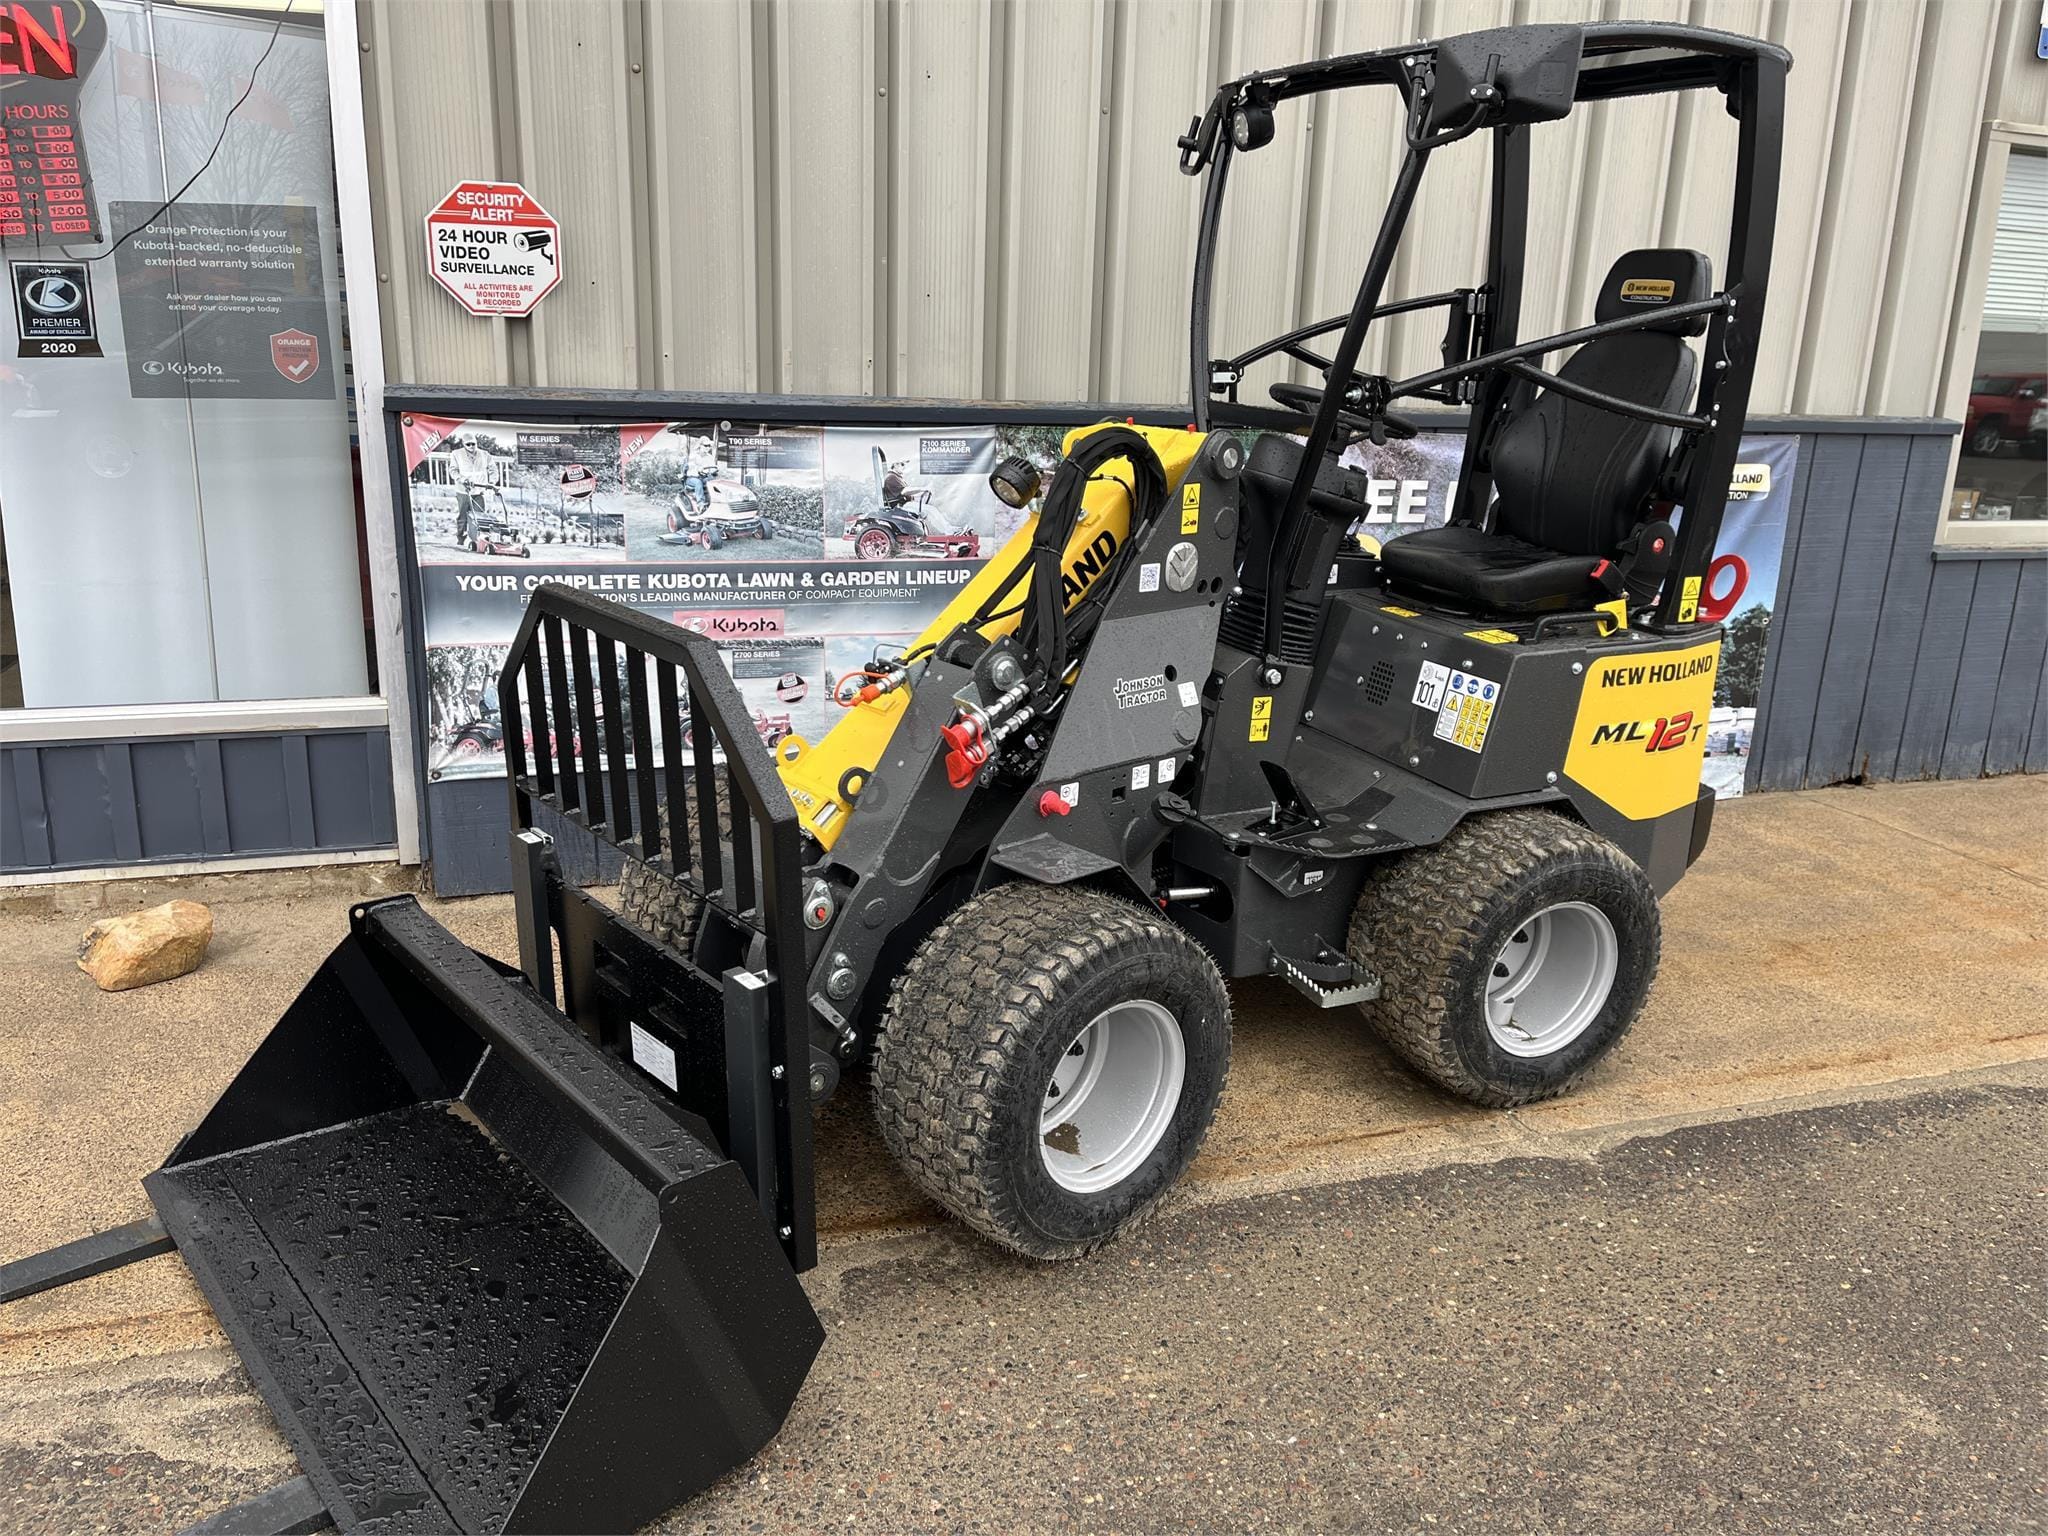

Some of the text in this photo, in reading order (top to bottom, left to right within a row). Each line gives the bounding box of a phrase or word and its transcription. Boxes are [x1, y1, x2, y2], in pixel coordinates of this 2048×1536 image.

[5, 104, 69, 119] HOURS
[11, 128, 26, 137] TO
[15, 144, 29, 153] TO
[18, 160, 32, 169] TO
[23, 176, 36, 185] TO
[25, 192, 39, 201] TO
[53, 190, 79, 199] 5:00
[456, 191, 525, 207] SECURITY
[29, 208, 42, 216] TO
[51, 206, 84, 215] 12:00
[470, 207, 514, 222] ALERT
[32, 223, 45, 232] TO
[55, 221, 85, 230] CLOSED
[145, 223, 288, 239] Orange Protection is your
[438, 228, 508, 244] 24 HOUR
[133, 239, 302, 255] Kubota-backed, no-deductible
[439, 245, 490, 260] VIDEO
[144, 256, 295, 270] extended warranty solution
[440, 261, 535, 276] SURVEILLANCE
[463, 282, 534, 292] ALL ACTIVITIES ARE
[166, 292, 183, 301] Ask
[184, 294, 202, 303] your
[204, 293, 229, 302] dealer
[230, 294, 249, 302] how
[250, 295, 265, 304] you
[476, 291, 521, 299] MONITORED
[168, 303, 282, 314] extend your coverage today.
[483, 299, 522, 307] RECORDED
[32, 318, 81, 327] PREMIER
[41, 342, 77, 353] 2020
[277, 338, 312, 346] ORANGE
[167, 361, 223, 376] Kubota
[420, 429, 442, 454] NEW
[529, 435, 560, 443] SERIES
[623, 434, 645, 458] NEW
[921, 446, 971, 454] KOMMANDER
[456, 574, 518, 591] YOUR
[647, 573, 731, 589] KUBOTA
[737, 572, 794, 588] LAWN
[800, 572, 814, 587] &
[820, 570, 899, 586] GARDEN
[906, 569, 971, 584] LINEUP
[640, 592, 690, 602] LEADING
[693, 590, 786, 602] MANUFACTURER
[788, 590, 803, 600] OF
[805, 589, 856, 599] COMPACT
[713, 617, 776, 632] Kubota
[1602, 655, 1713, 688] NEW HOLLAND
[1114, 675, 1164, 694] JOHNSON
[1117, 690, 1167, 708] TRACTOR
[1416, 680, 1436, 706] 101
